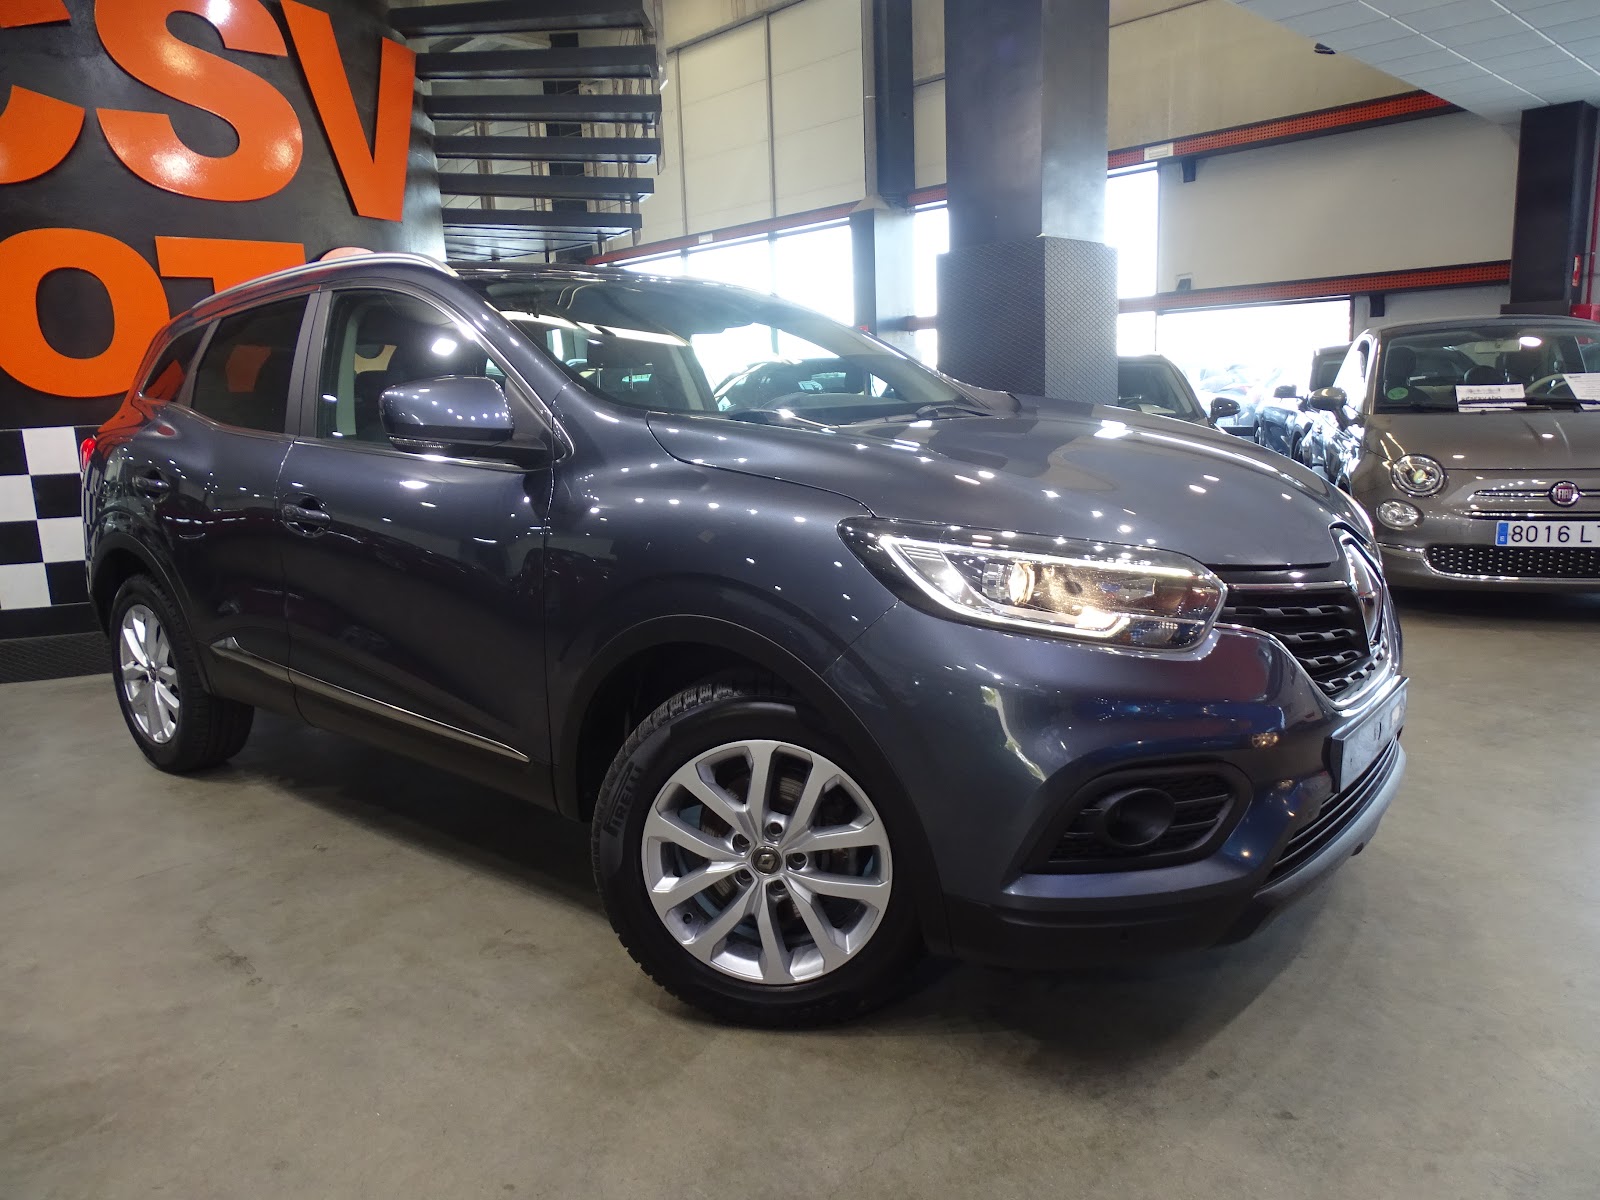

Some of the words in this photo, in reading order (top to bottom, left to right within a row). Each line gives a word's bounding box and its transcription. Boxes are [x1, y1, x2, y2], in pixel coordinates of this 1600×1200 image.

[1557, 488, 1573, 500] FIAT
[1511, 525, 1571, 543] 8016
[1580, 525, 1600, 543] L
[602, 761, 642, 838] PIRELLI
